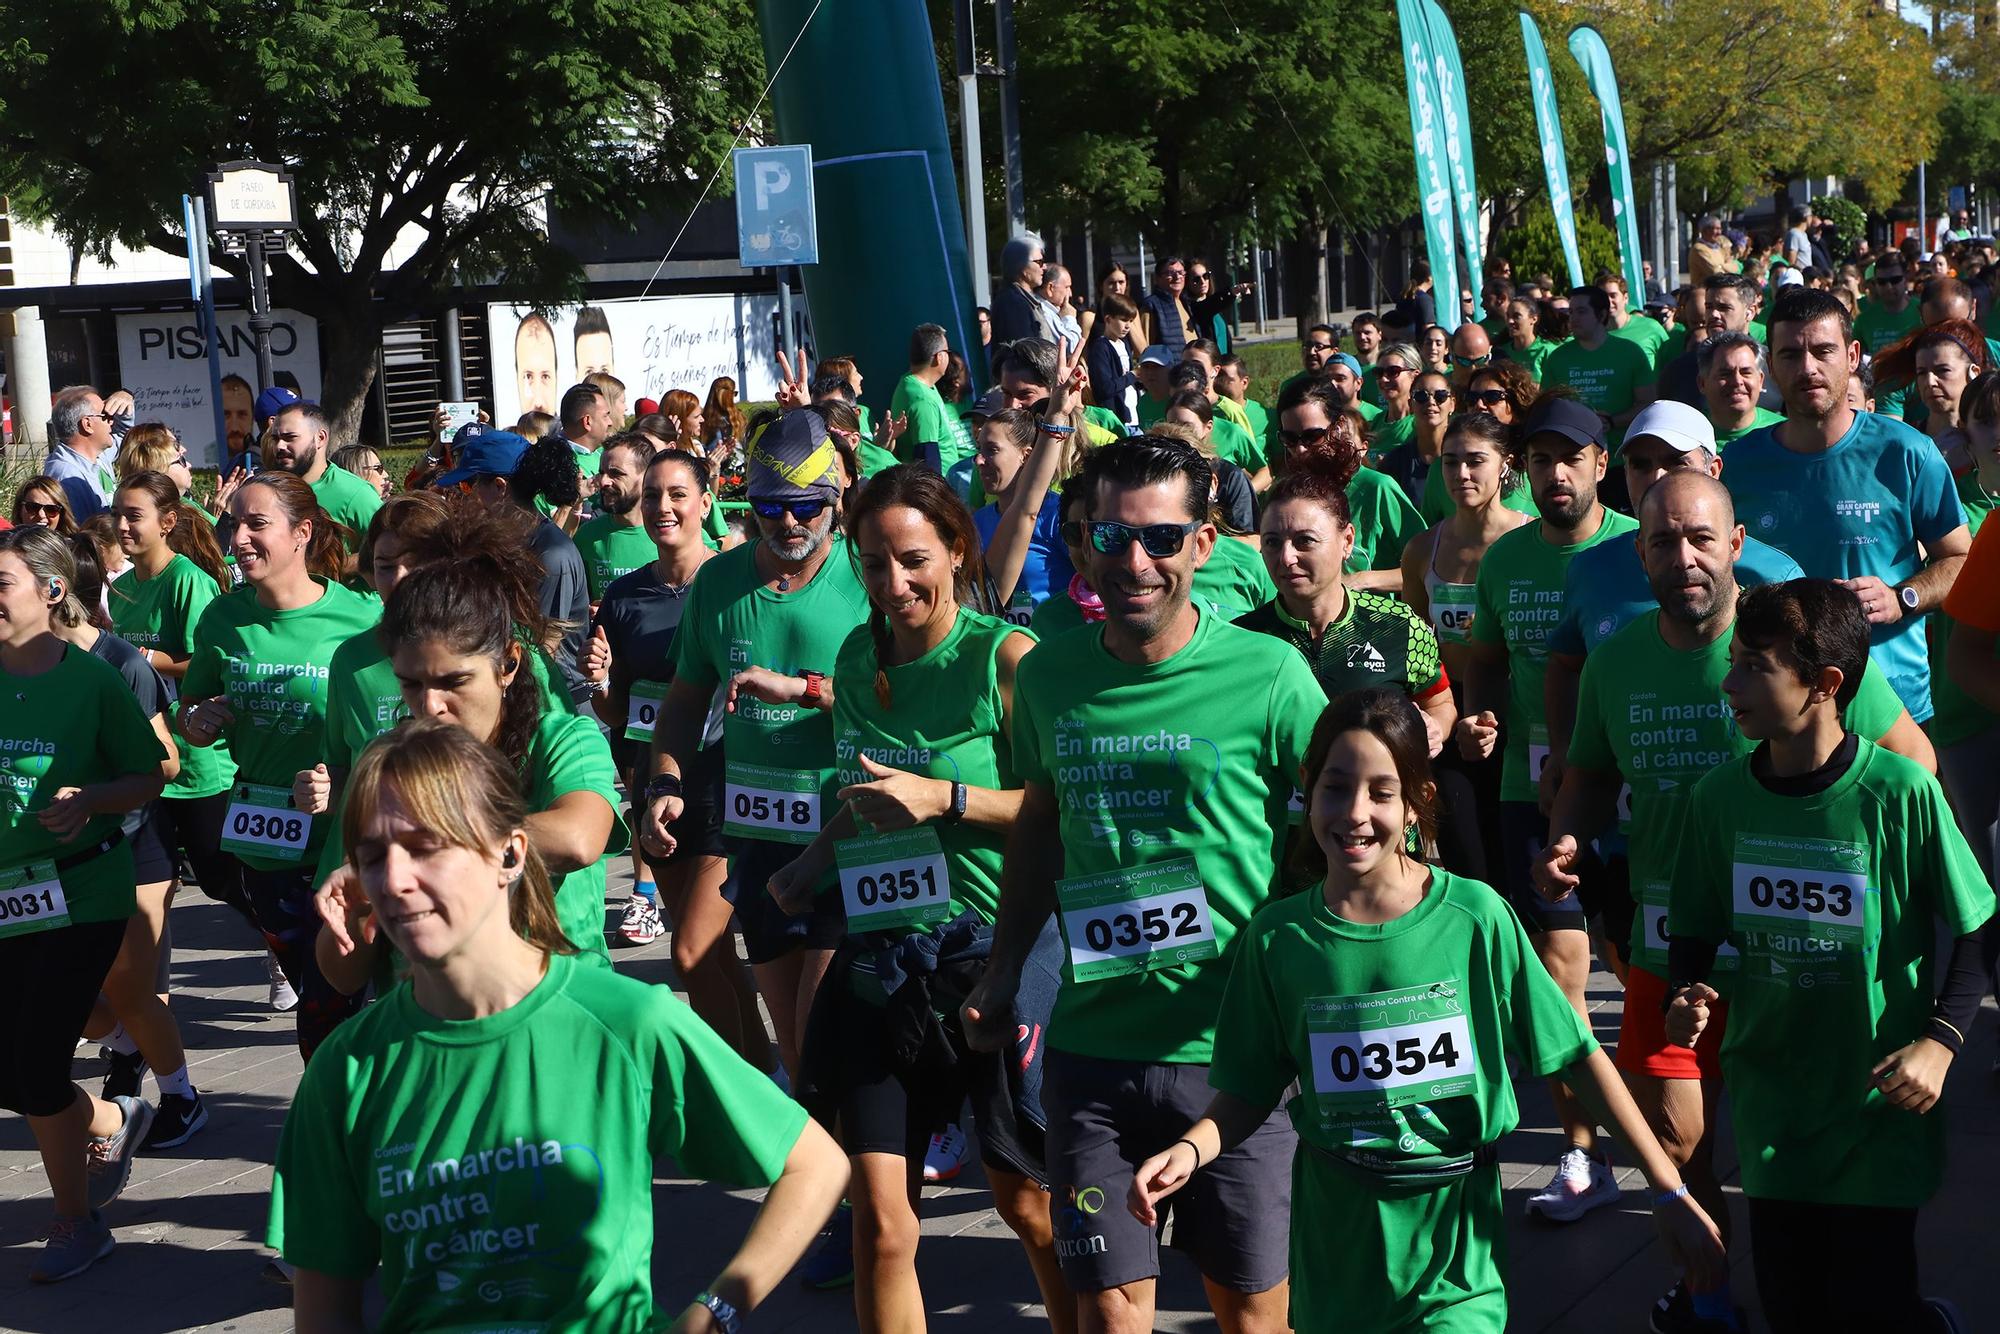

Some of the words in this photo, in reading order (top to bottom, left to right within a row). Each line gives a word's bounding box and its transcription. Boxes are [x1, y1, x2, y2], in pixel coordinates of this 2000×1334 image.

[241, 182, 264, 193] PASEO
[754, 161, 791, 211] P
[231, 199, 241, 210] DE
[1854, 501, 1880, 510] CAPITÁN
[1509, 588, 1528, 604] En
[1508, 607, 1559, 622] contra
[123, 631, 160, 642] marcha
[1508, 625, 1519, 640] el
[730, 647, 747, 662] En
[231, 660, 249, 674] En
[256, 662, 329, 679] marcha
[231, 679, 284, 694] contra
[249, 696, 311, 713] cáncer
[744, 704, 797, 720] cáncer
[1629, 704, 1653, 723] En
[1055, 733, 1082, 757] En
[1091, 729, 1191, 754] marcha
[1631, 726, 1697, 746] contra
[836, 739, 855, 760] En
[862, 744, 932, 765] marcha
[1632, 750, 1647, 769] el
[1654, 747, 1730, 768] cáncer
[1058, 760, 1134, 784] contra
[1066, 788, 1081, 809] el
[1085, 785, 1173, 810] cáncer
[734, 793, 811, 824] 0518
[234, 812, 302, 842] 0308
[1778, 841, 1803, 850] Marcha
[1804, 843, 1829, 852] Contra
[857, 866, 936, 906] 0351
[1093, 878, 1103, 887] En
[1104, 874, 1131, 886] Marcha
[1131, 869, 1157, 880] Contra
[1158, 867, 1166, 876] el
[1749, 876, 1852, 917] 0353
[1085, 902, 1202, 952] 0352
[1343, 1002, 1353, 1010] En
[1355, 1000, 1386, 1009] Marcha
[1387, 995, 1416, 1005] Contra
[1418, 992, 1426, 1001] el
[1331, 1031, 1459, 1083] 0354
[377, 1165, 415, 1198] En
[427, 1136, 563, 1188] marcha
[384, 1191, 490, 1233] contra
[424, 1222, 539, 1262] cáncer
